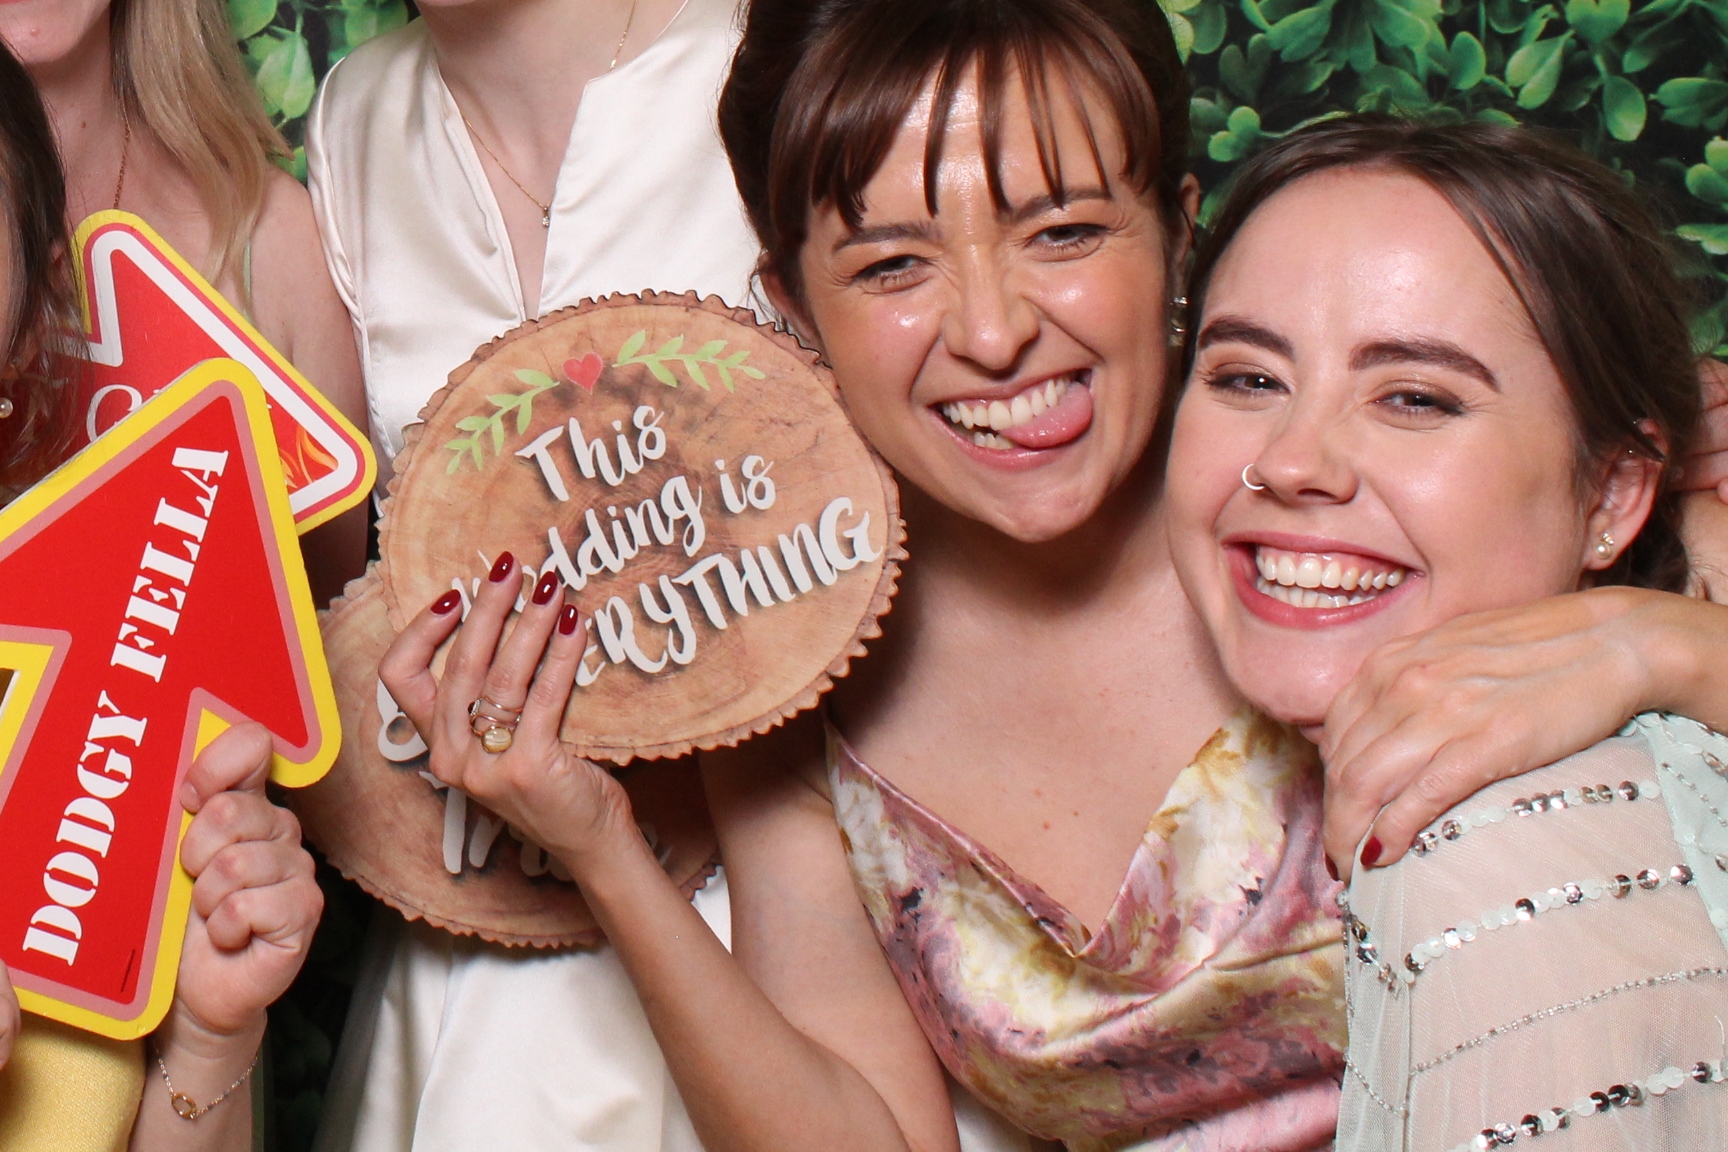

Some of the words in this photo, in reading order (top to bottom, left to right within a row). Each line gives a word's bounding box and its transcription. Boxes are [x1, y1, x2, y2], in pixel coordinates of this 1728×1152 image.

[514, 404, 667, 501] This
[714, 454, 777, 514] is
[575, 496, 883, 686] ERYTHING
[22, 689, 148, 966] DODGY
[110, 447, 229, 683] FELLA
